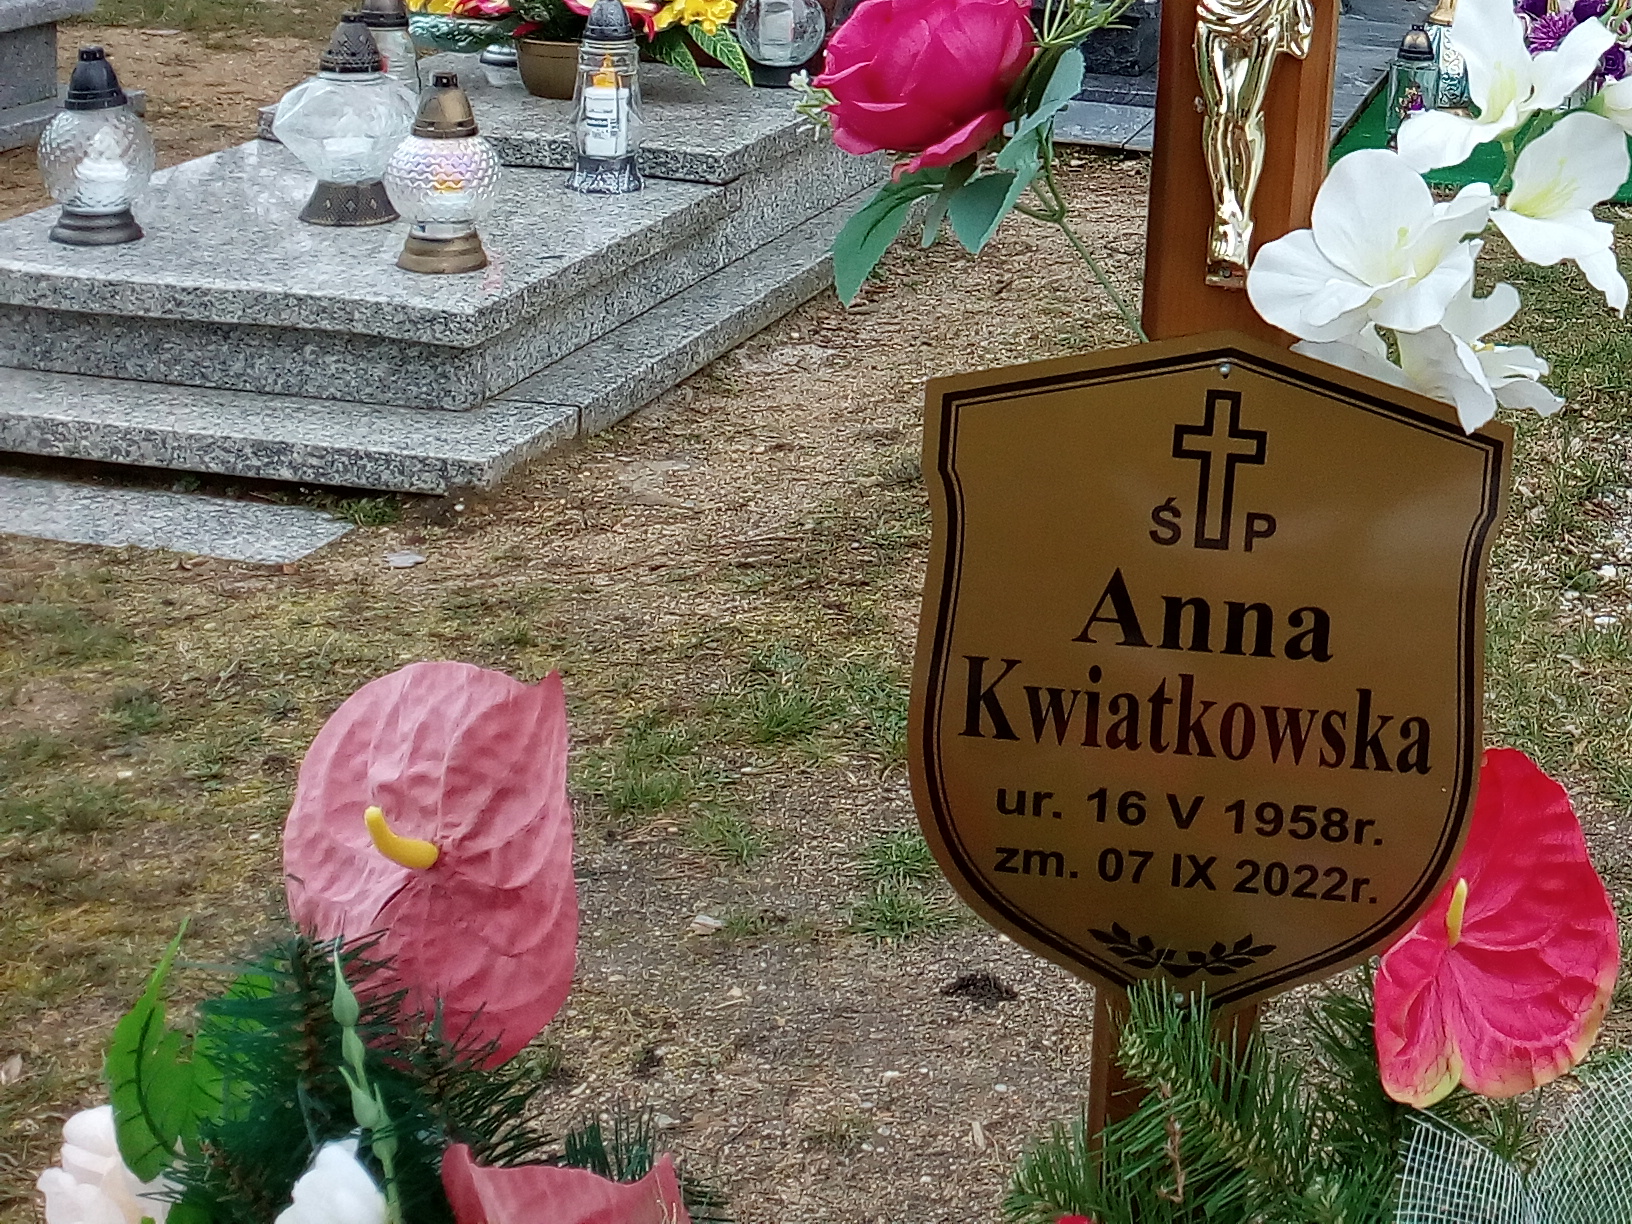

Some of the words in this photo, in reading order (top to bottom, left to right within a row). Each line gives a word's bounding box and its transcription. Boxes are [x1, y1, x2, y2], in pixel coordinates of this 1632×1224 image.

[1149, 497, 1182, 546] Ś
[1244, 511, 1277, 552] P
[1071, 567, 1334, 663] Anna
[958, 655, 1433, 775] Kwiatkowska
[996, 787, 1063, 819] ur.
[1087, 787, 1147, 826] 16
[1166, 793, 1205, 830] V
[1224, 799, 1383, 846] 1958r.
[994, 846, 1079, 879] zm.
[1098, 847, 1154, 884] 07
[1170, 853, 1217, 891] IX
[1232, 859, 1378, 904] 2022r.
